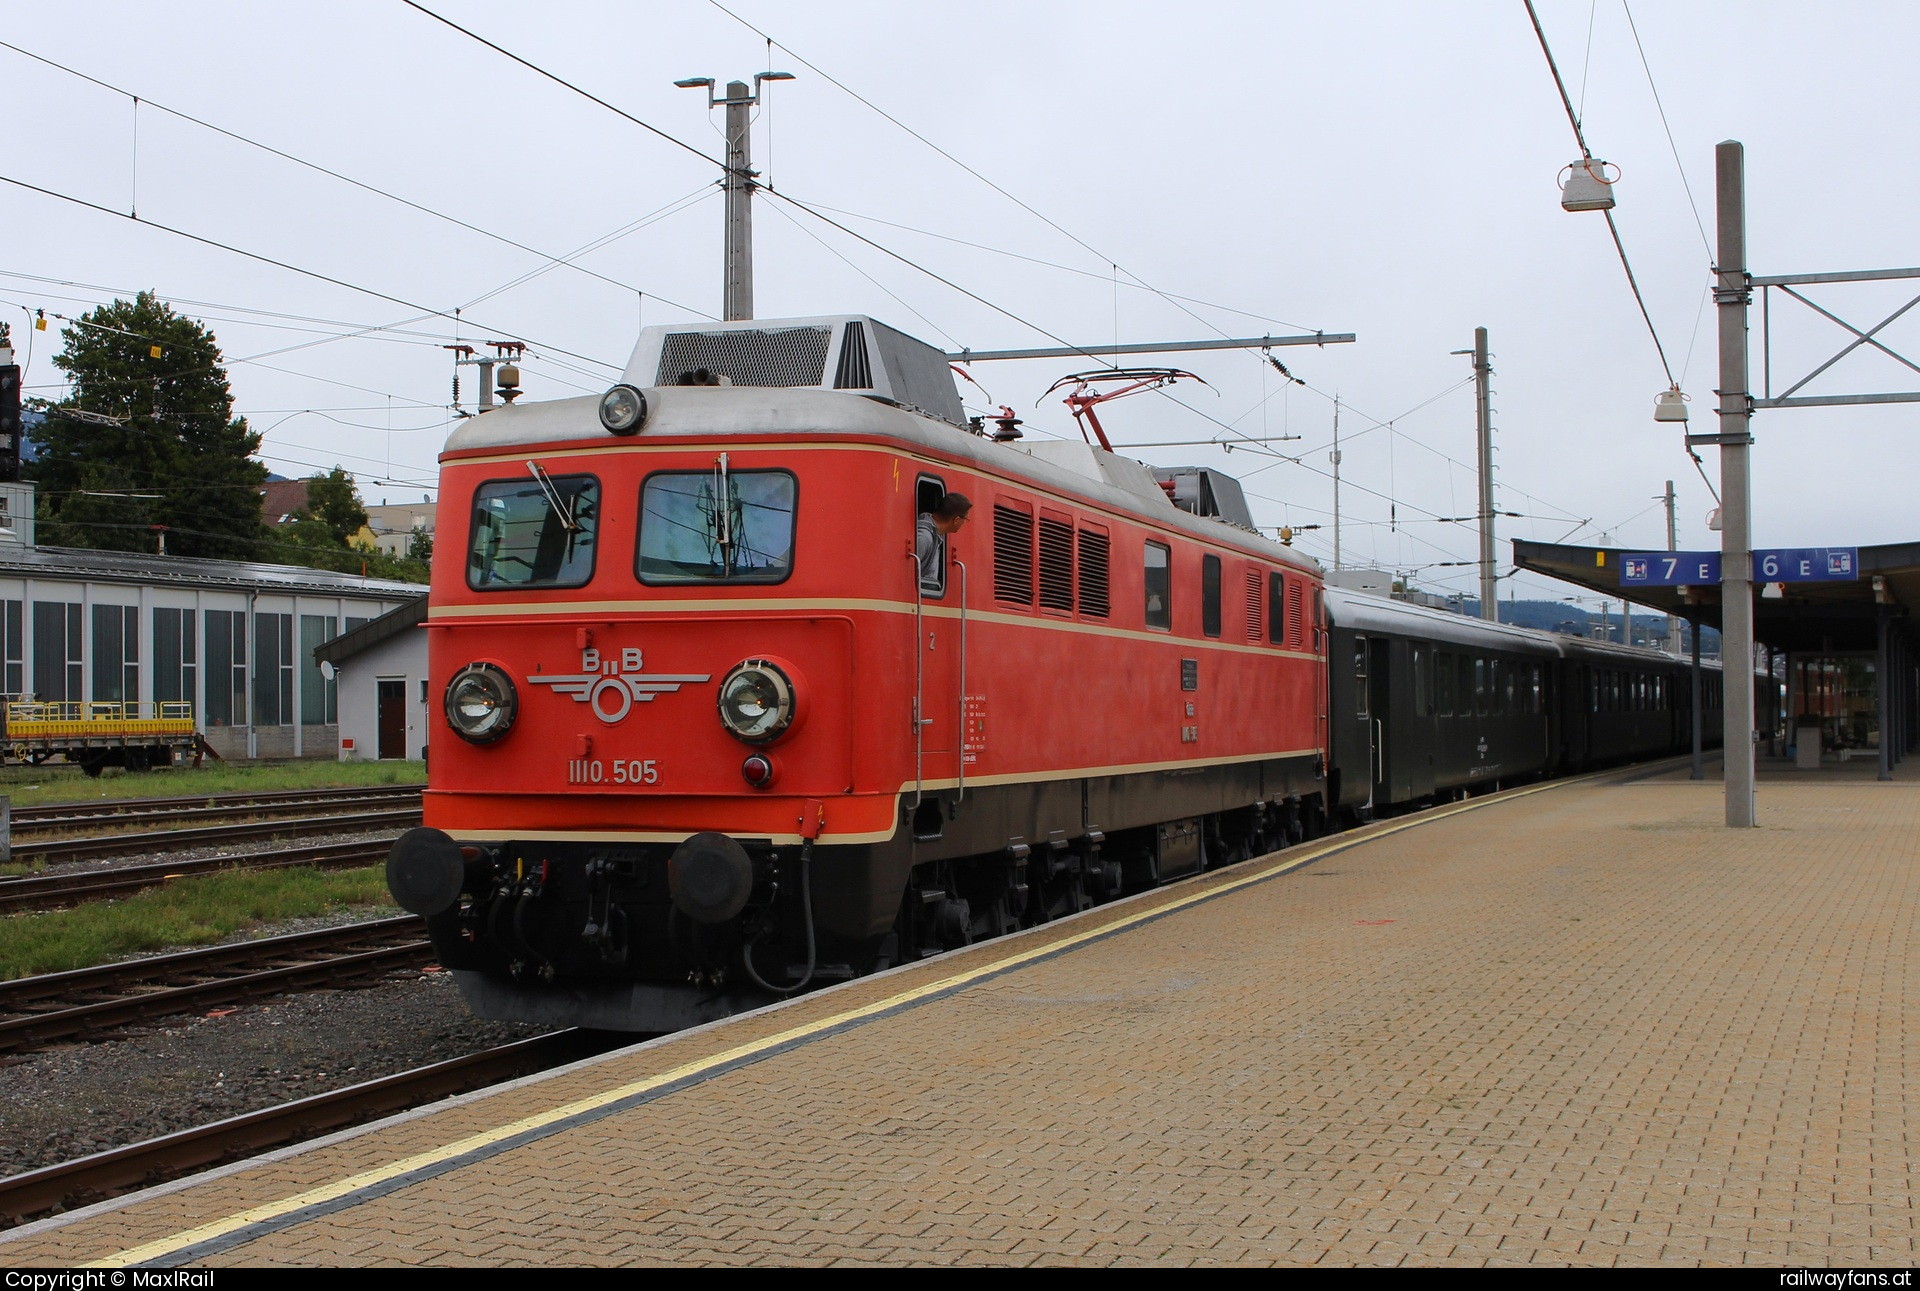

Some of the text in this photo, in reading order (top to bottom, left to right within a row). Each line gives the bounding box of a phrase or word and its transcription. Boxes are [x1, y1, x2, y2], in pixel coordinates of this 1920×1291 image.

[1661, 558, 1709, 579] 7 E
[1762, 555, 1811, 576] 6 E
[929, 632, 936, 650] 2
[569, 759, 658, 784] 1110.505
